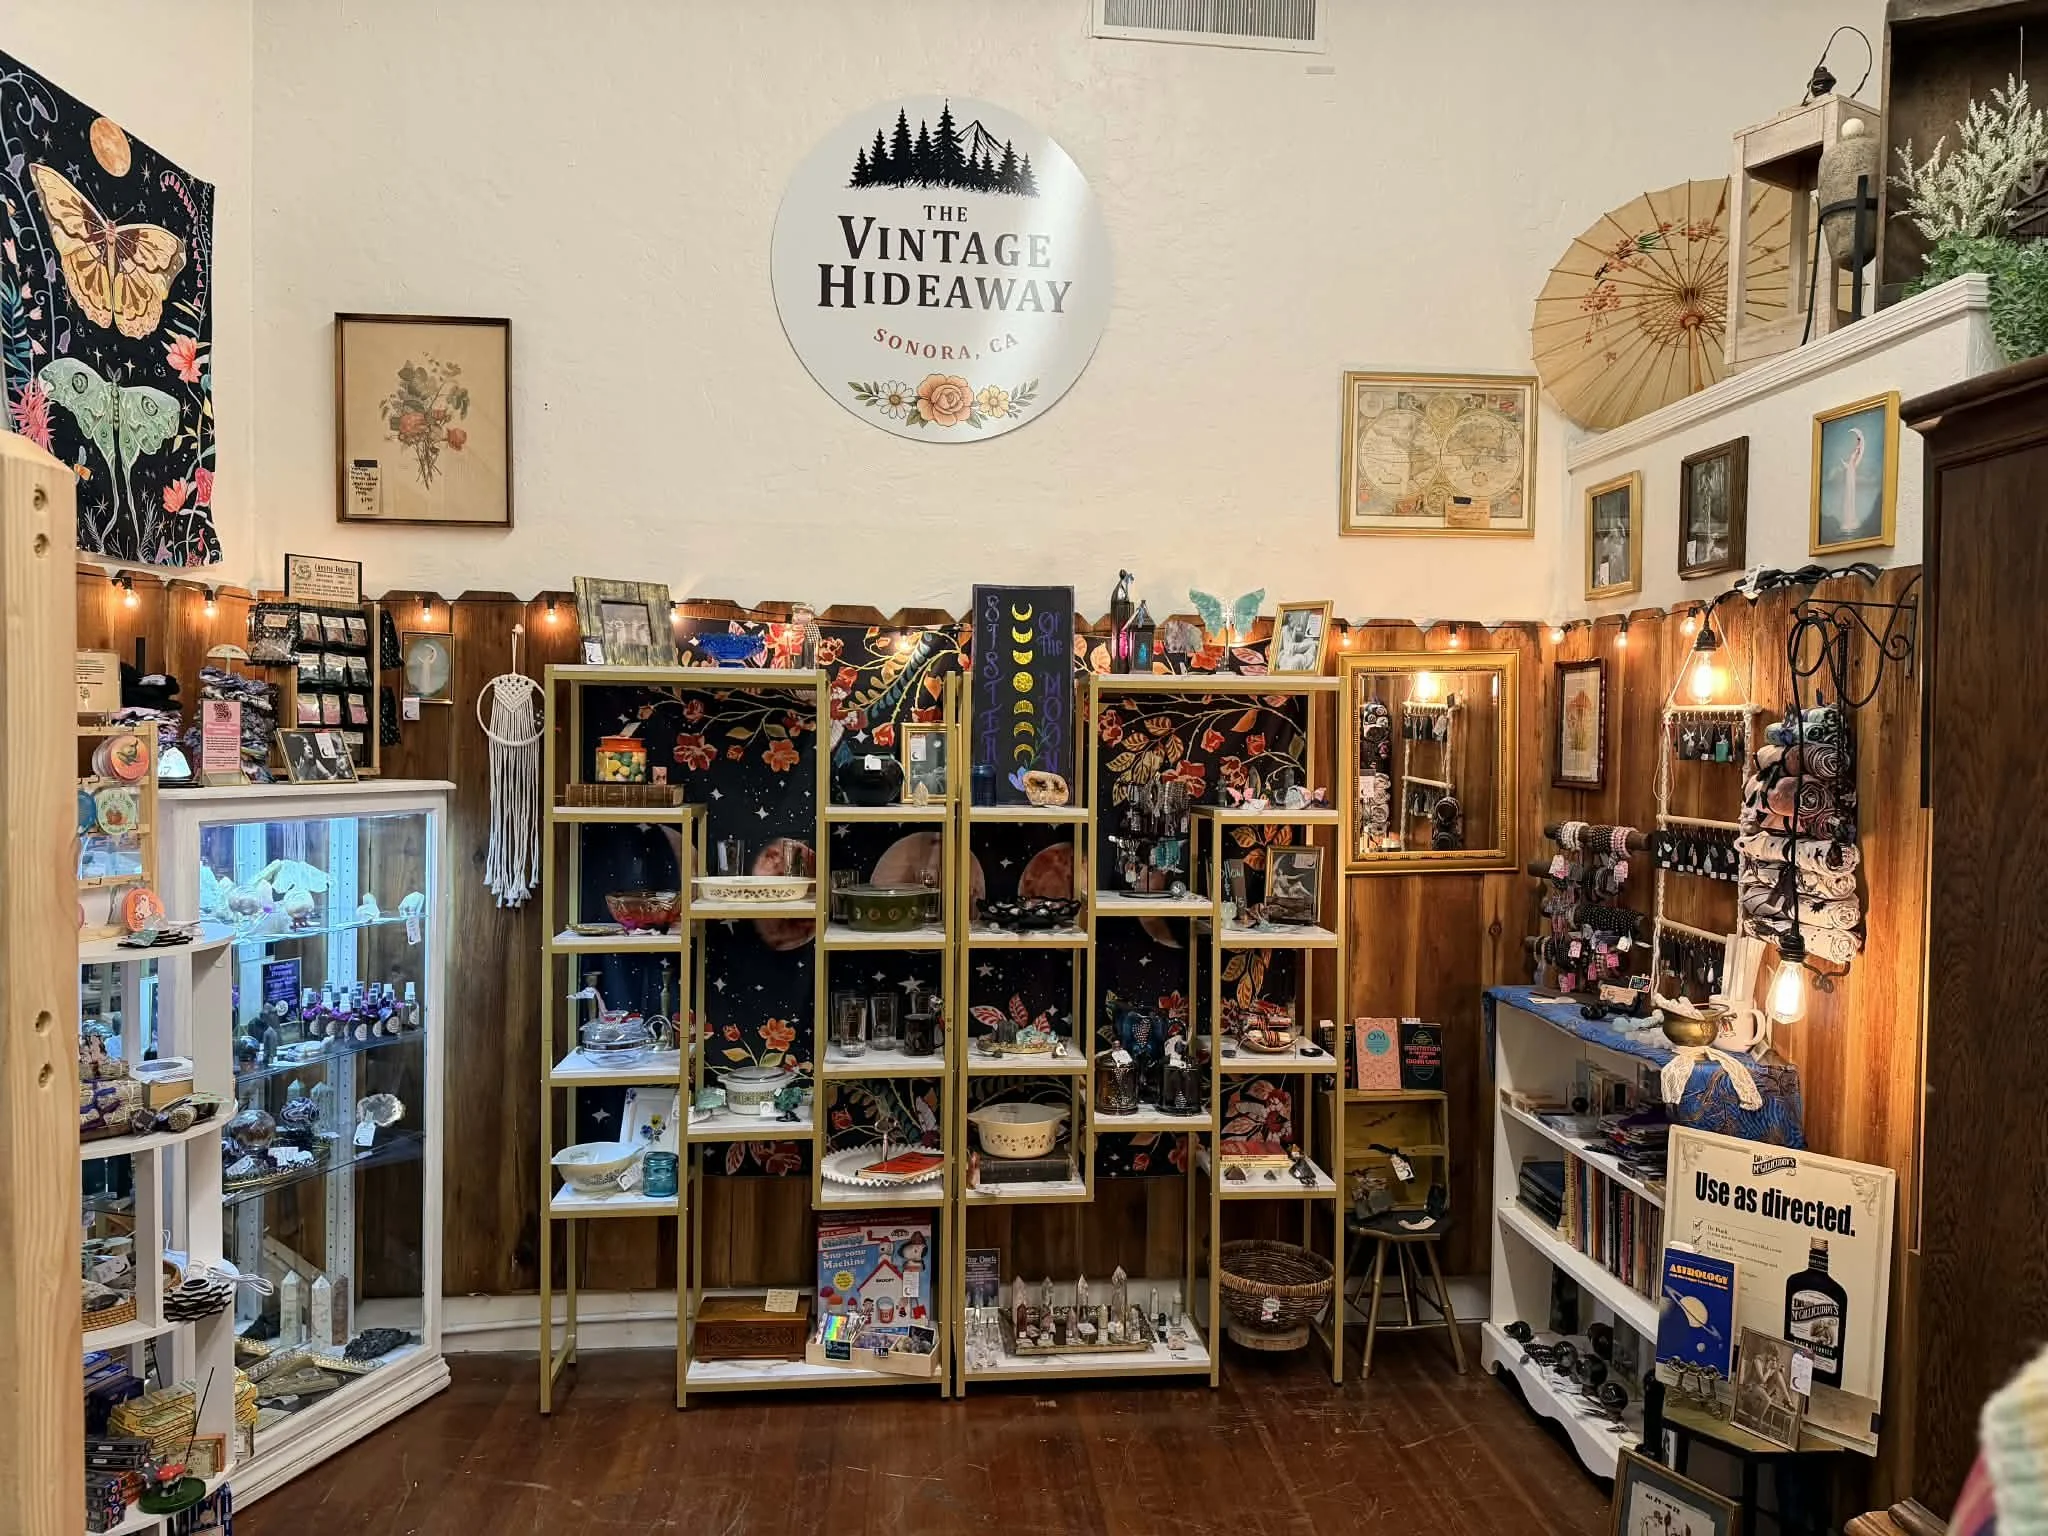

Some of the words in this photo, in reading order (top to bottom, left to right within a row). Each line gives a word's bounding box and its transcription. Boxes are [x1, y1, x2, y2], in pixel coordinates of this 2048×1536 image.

[923, 205, 968, 222] THE
[838, 215, 1051, 268] VINTAGE
[817, 263, 1072, 313] HIDEAWAY
[873, 328, 980, 360] SONORA,
[989, 333, 1018, 353] CA
[1367, 1032, 1386, 1041] OM
[1695, 1171, 1730, 1206] Use
[1734, 1185, 1758, 1213] as
[1761, 1187, 1856, 1237] directed.
[823, 1258, 865, 1270] Machine
[1670, 1263, 1729, 1284] ASTROLOGY
